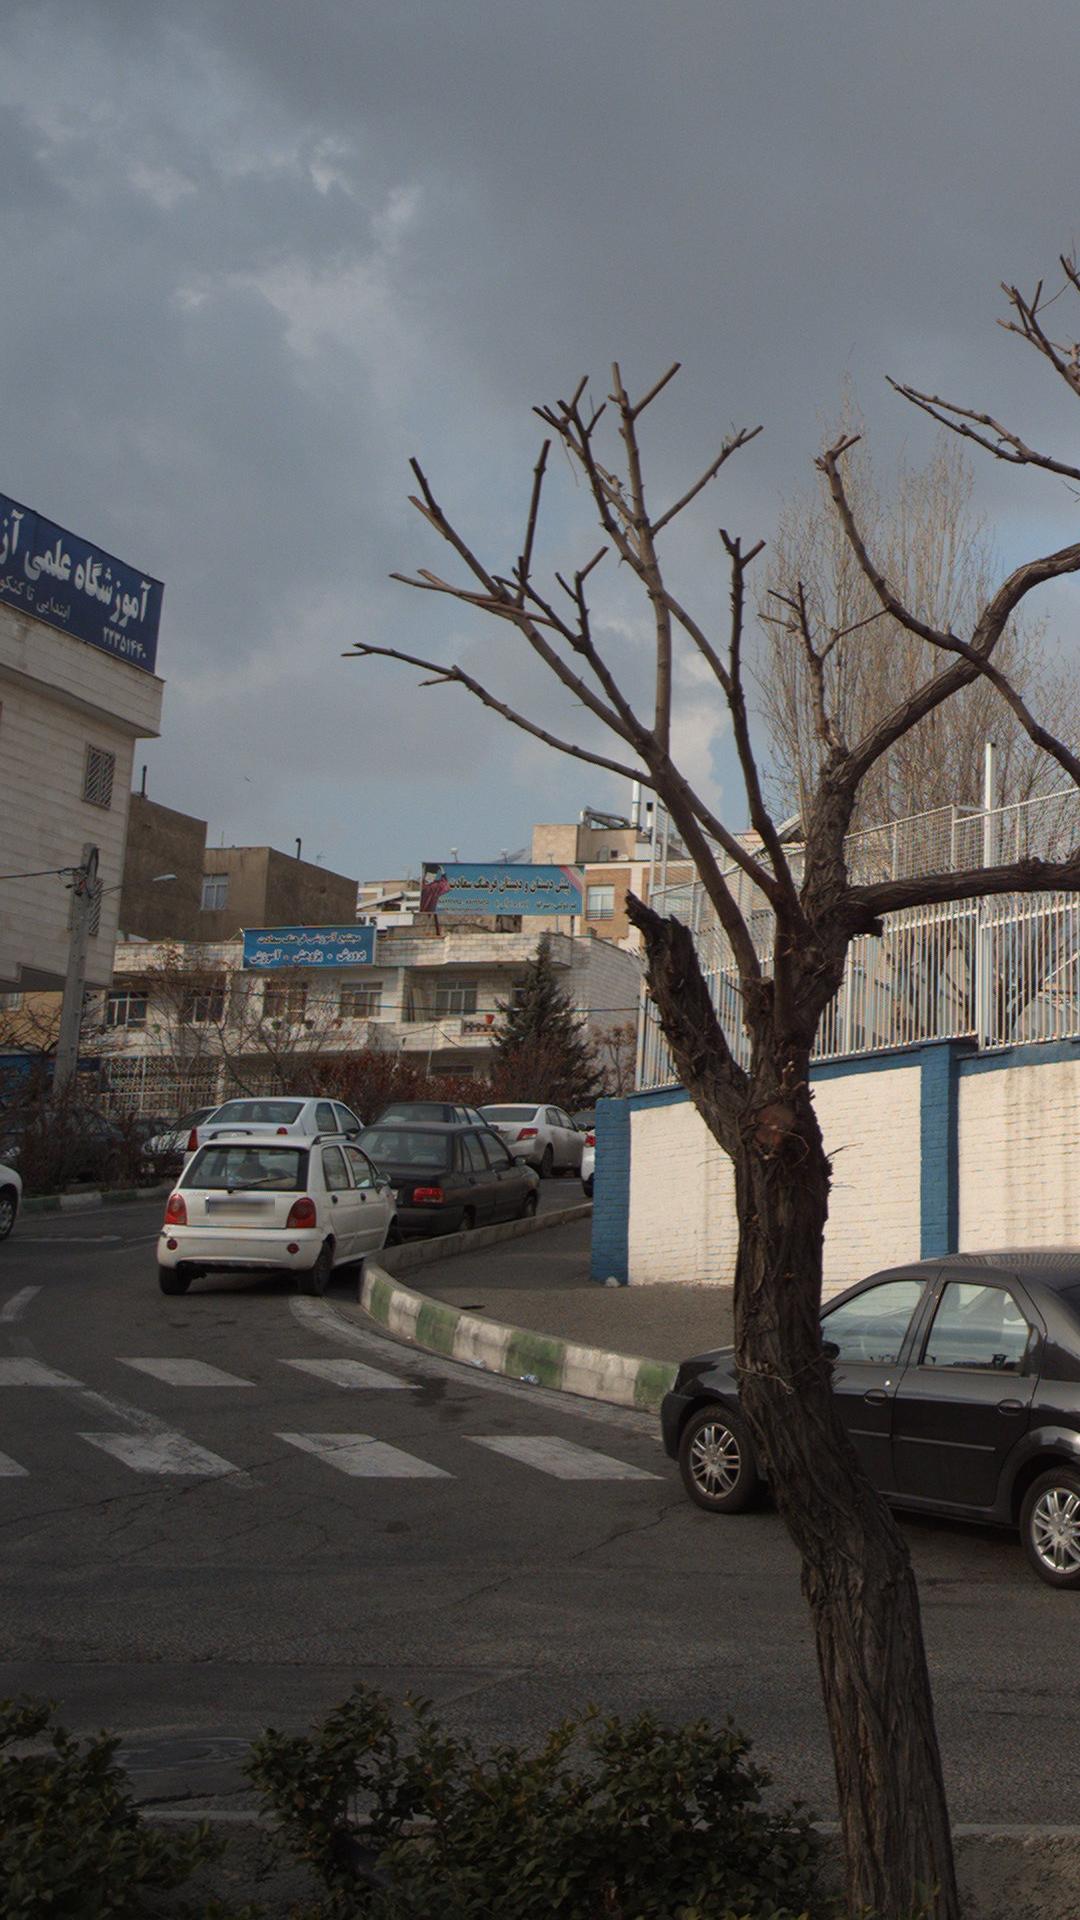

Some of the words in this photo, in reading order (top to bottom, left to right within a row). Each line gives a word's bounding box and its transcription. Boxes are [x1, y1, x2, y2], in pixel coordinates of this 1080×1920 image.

[24, 539, 72, 581] علمی
[26, 585, 35, 601] تا
[74, 555, 152, 628] آموزشگاه
[449, 876, 472, 889] سعادت
[473, 875, 498, 895] فرهنگ
[498, 875, 523, 895] دبستان
[523, 880, 529, 895] و
[530, 876, 554, 895] دبستان
